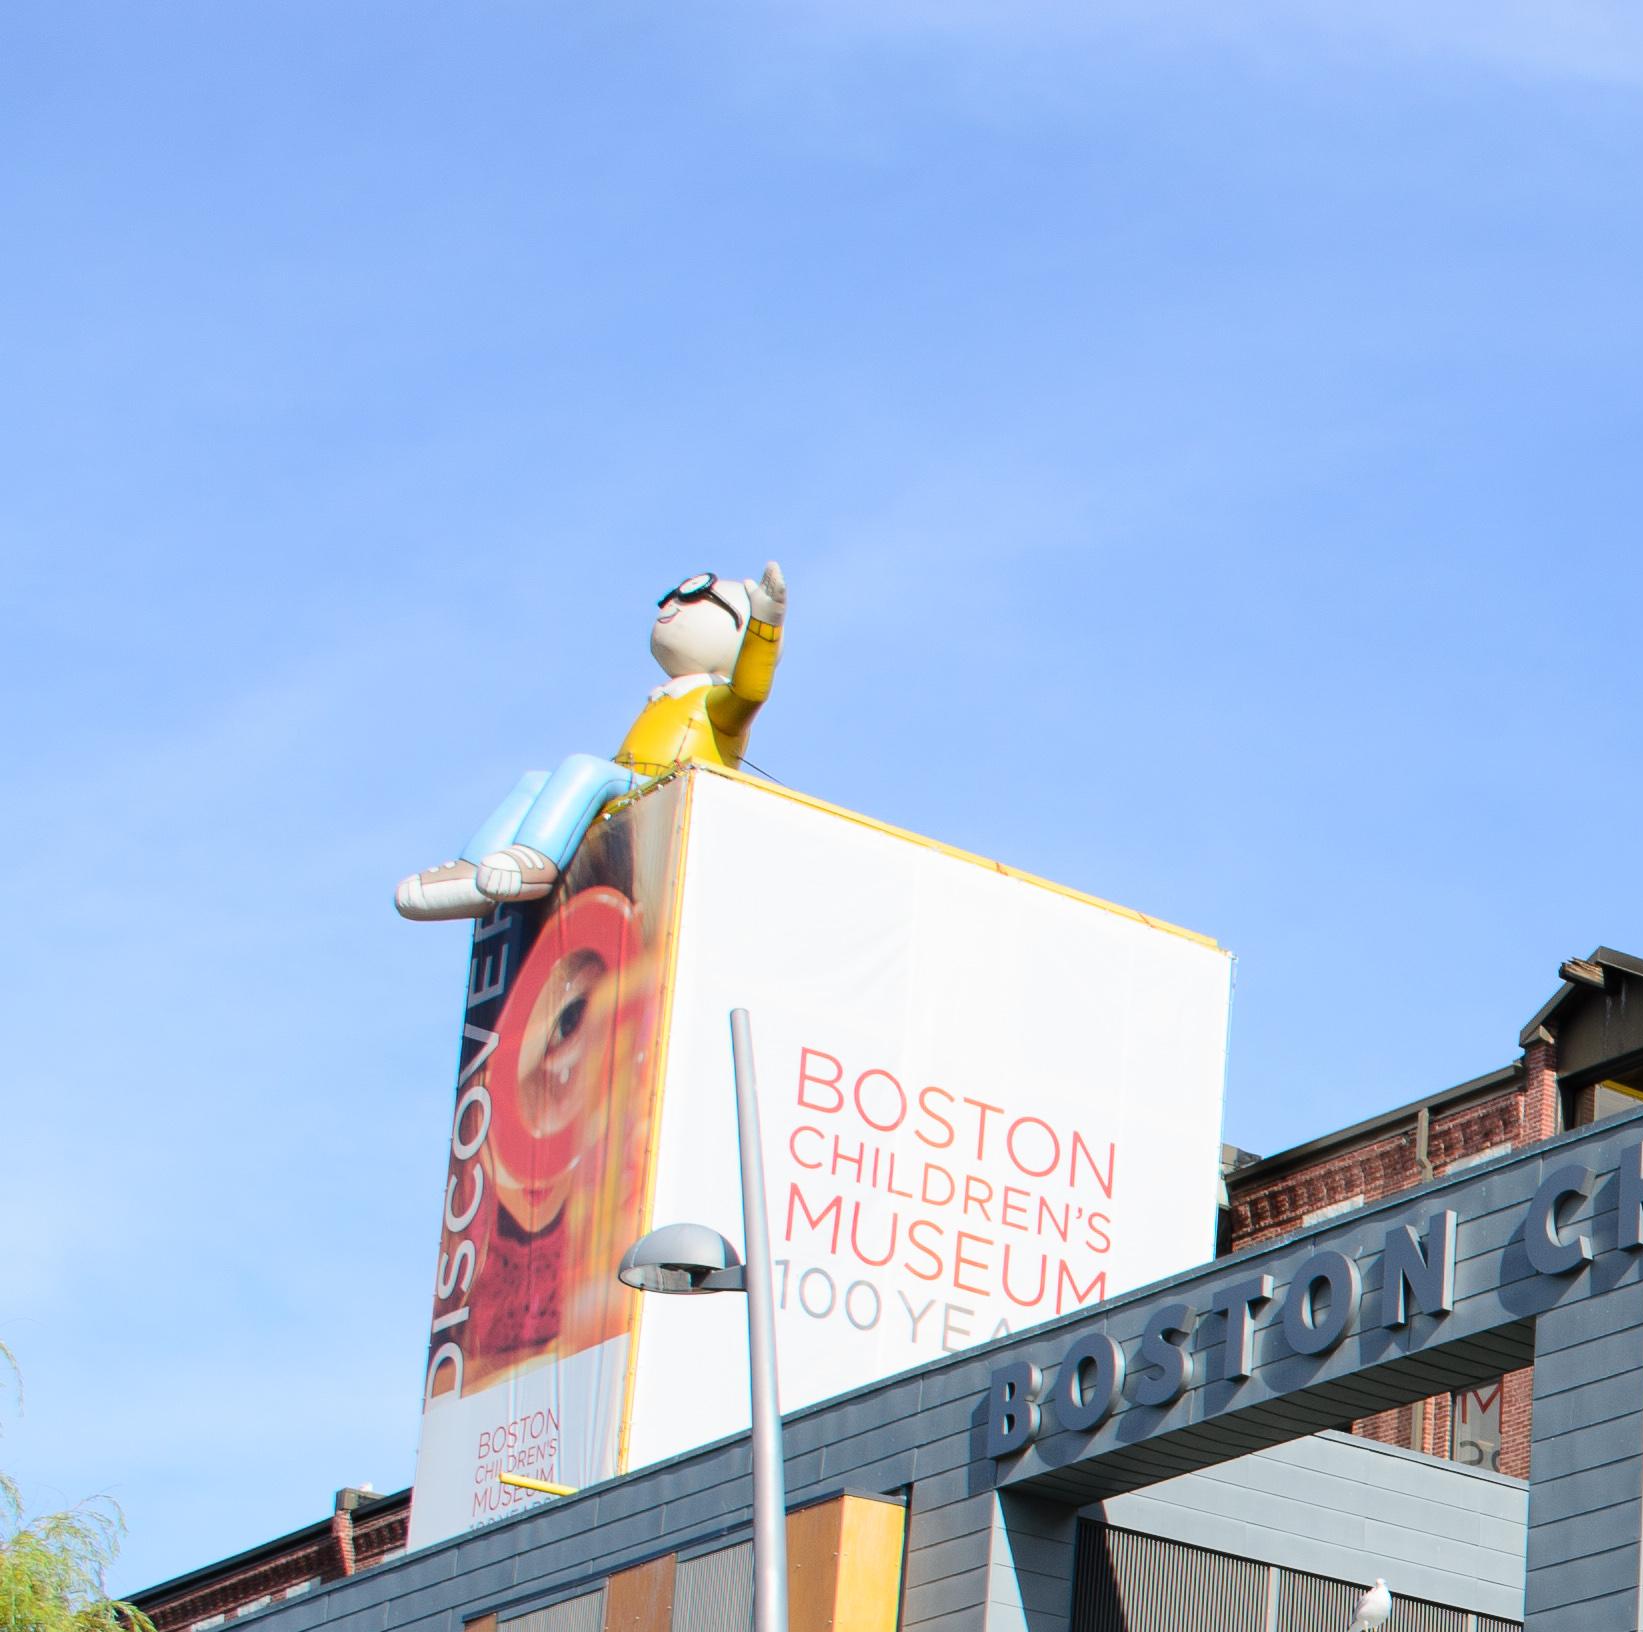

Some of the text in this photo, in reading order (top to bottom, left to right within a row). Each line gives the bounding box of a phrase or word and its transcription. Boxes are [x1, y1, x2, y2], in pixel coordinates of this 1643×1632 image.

[797, 1047, 1116, 1201] BOSTON
[785, 1182, 1106, 1316] MUSEUM
[789, 1125, 1111, 1254] CHILDREN'S
[775, 1259, 882, 1332] 100
[987, 1209, 1458, 1461] BOSTON
[475, 1438, 557, 1484] CHILDREN'S
[478, 1407, 560, 1460] BOSTON
